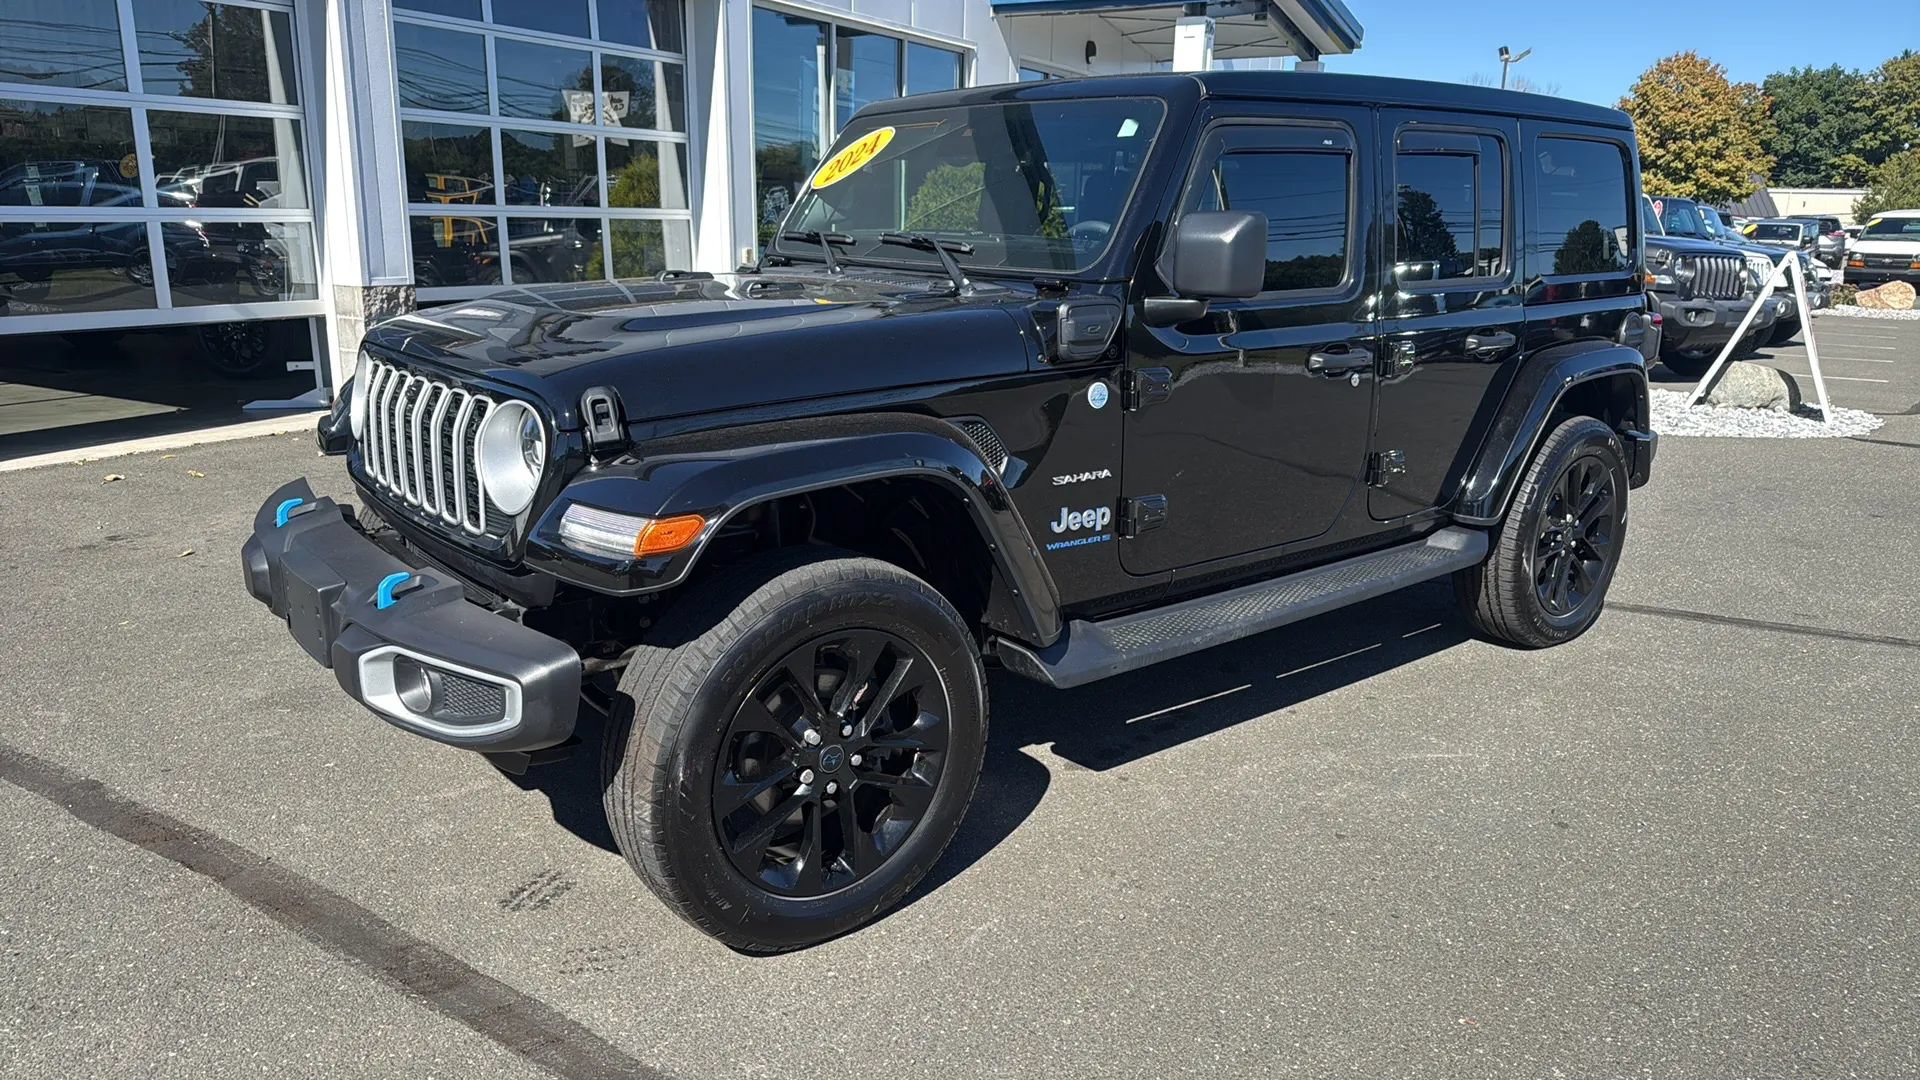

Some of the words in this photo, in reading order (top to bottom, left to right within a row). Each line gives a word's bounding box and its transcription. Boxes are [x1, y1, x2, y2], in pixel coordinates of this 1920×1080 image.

[824, 133, 881, 183] 2024
[1052, 469, 1112, 485] SAHARA
[1051, 506, 1111, 533] Jeep
[1046, 536, 1101, 550] WRANGLER
